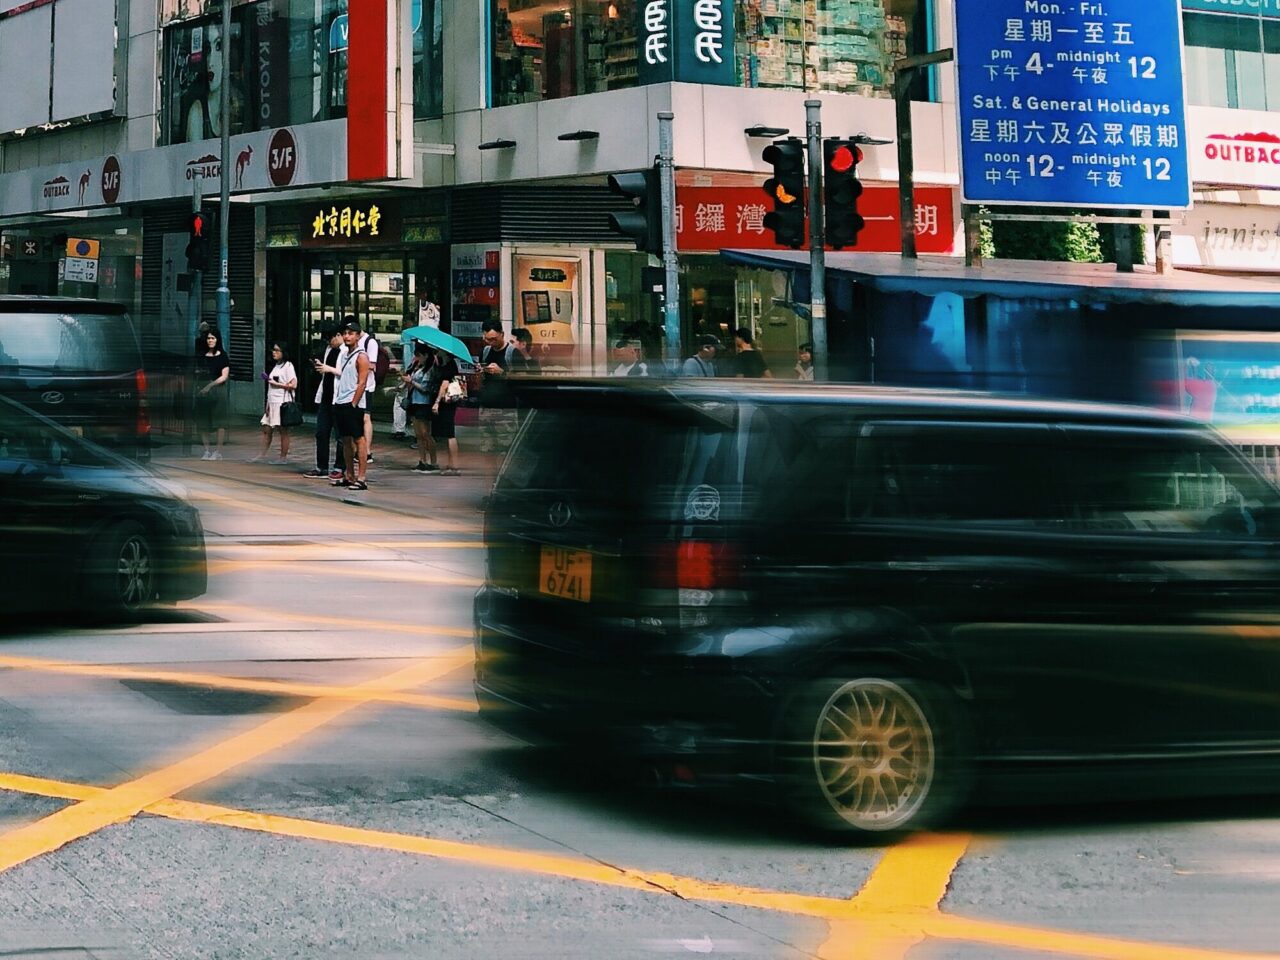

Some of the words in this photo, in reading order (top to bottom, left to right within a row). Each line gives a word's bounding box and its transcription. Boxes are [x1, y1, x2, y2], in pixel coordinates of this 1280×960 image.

[1024, 0, 1066, 15] Mon.
[1080, 2, 1109, 17] Fri.
[1003, 18, 1135, 46] 星期一至五
[983, 64, 1021, 82] 下午
[1071, 66, 1108, 85] 午夜
[991, 49, 1013, 60] pm
[1056, 50, 1121, 65] midnight
[1127, 56, 1157, 79] 12
[972, 95, 1007, 110] Sat.
[1012, 96, 1022, 110] &
[1026, 96, 1093, 113] General
[1097, 98, 1171, 117] Holidays
[969, 118, 1179, 149] 星期六及公眾假期
[272, 142, 293, 170] 3/F
[984, 153, 1020, 163] noon
[1071, 153, 1137, 168] midnight
[1142, 157, 1171, 180] 12
[103, 170, 119, 189] 3/F
[985, 167, 1022, 186] 中午
[1086, 169, 1123, 188] 午夜
[43, 184, 70, 199] OUTBACK
[312, 205, 382, 238] 北京同仁堂
[540, 329, 558, 337] G/F
[547, 570, 583, 600] 6741
